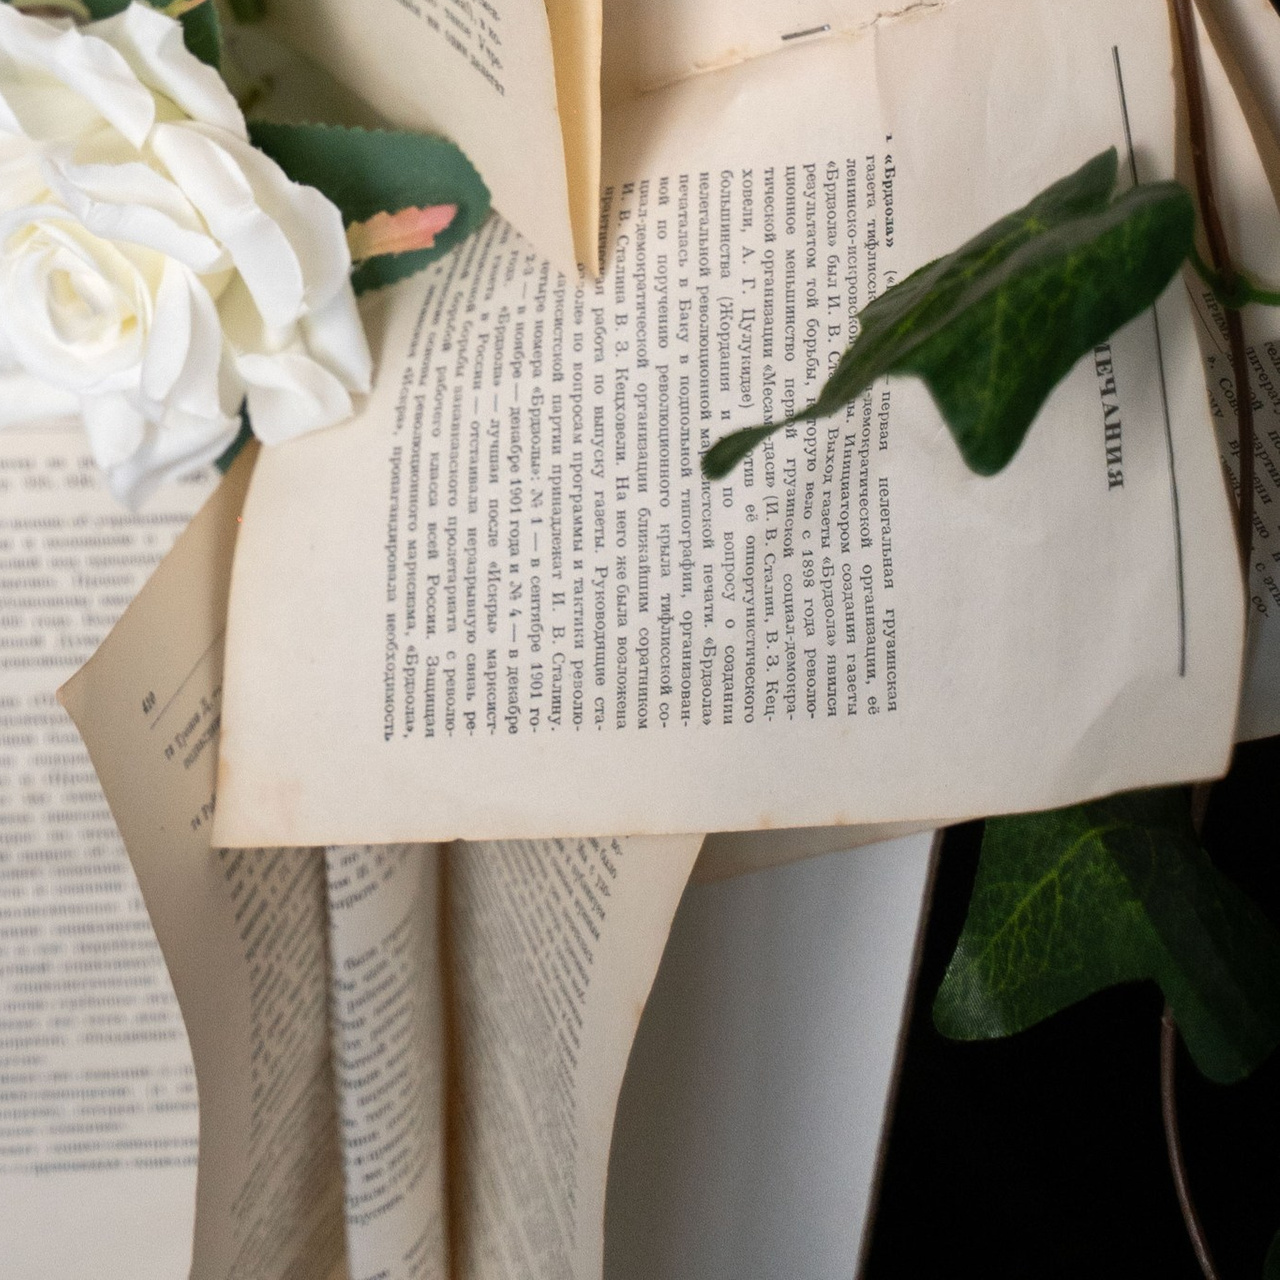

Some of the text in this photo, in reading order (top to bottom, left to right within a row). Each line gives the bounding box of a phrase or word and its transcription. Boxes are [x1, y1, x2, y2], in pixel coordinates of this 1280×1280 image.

[760, 167, 777, 358] тической организации
[882, 154, 896, 247] «Брдзола»
[676, 174, 695, 727] печаталась в Баку в подпольной типографии, организован-
[878, 391, 890, 451] первая
[383, 446, 402, 742] пропагандировала необходимость
[879, 477, 894, 589] нелегальная
[802, 550, 817, 719] 1898 года револю-
[882, 609, 897, 712] грузинская
